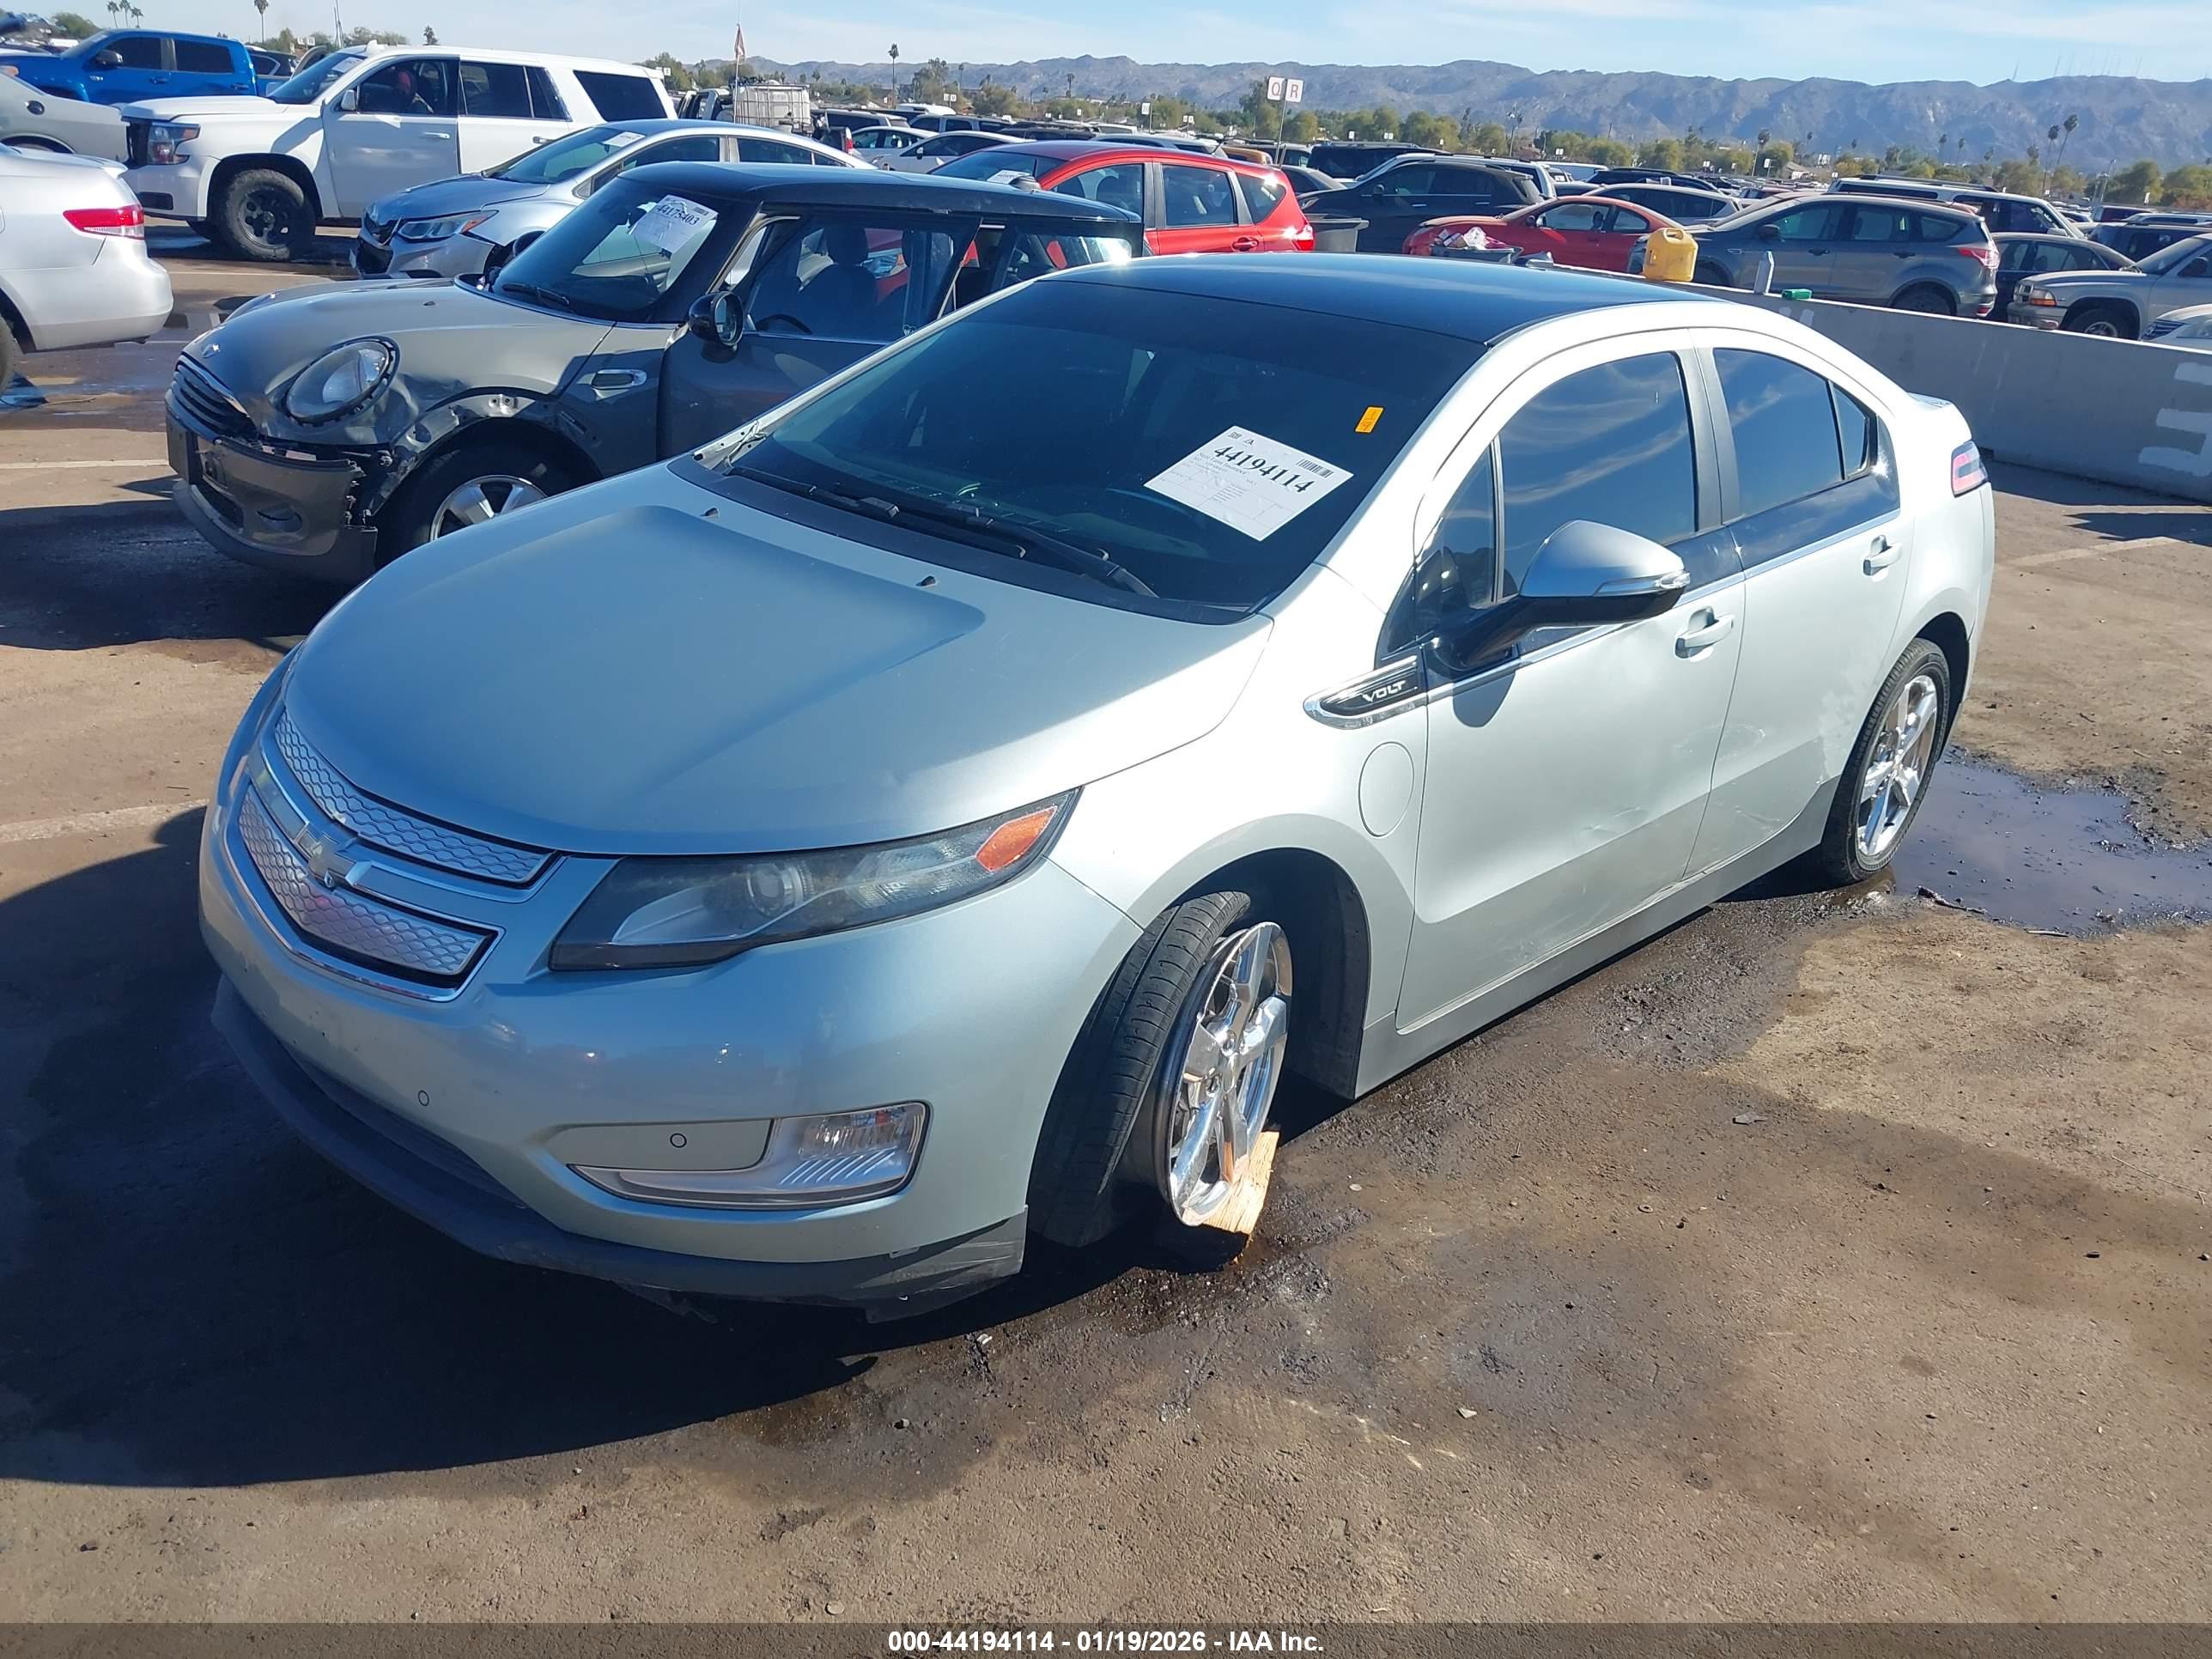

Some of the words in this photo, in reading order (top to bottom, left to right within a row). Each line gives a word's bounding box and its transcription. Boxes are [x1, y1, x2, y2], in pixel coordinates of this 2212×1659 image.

[1290, 83, 1299, 98] R
[657, 204, 700, 225] 44175403
[1213, 446, 1315, 492] 44194114
[1362, 680, 1406, 702] VOLT
